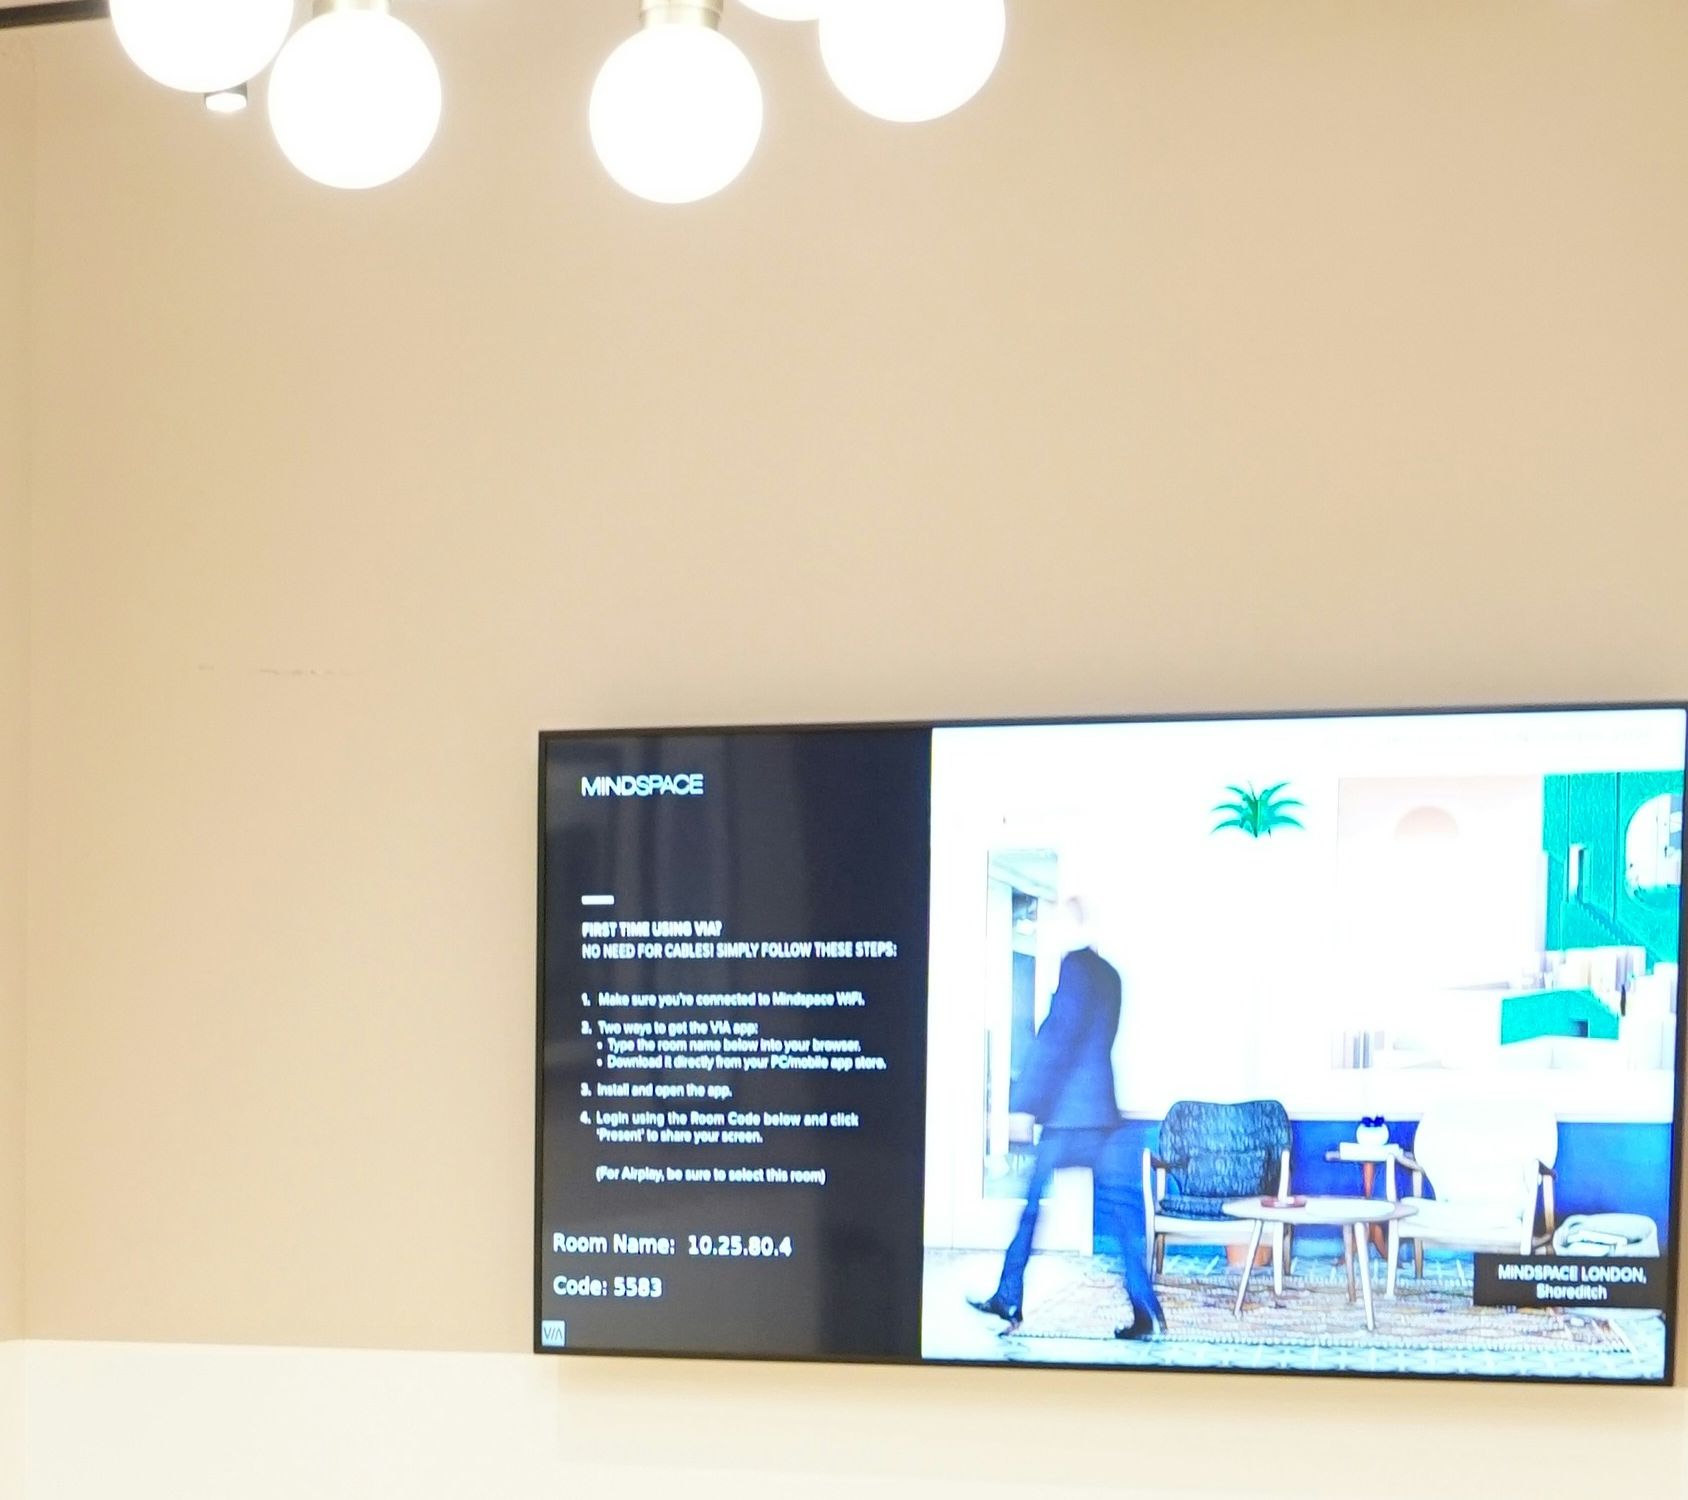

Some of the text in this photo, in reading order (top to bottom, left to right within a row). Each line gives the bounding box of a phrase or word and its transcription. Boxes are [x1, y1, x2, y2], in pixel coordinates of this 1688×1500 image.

[581, 774, 704, 796] MINDSPACE
[582, 920, 722, 937] FIRST TIME USING VIA?
[582, 943, 601, 959] NO
[603, 943, 635, 959] NEED
[637, 943, 662, 959] FOR
[716, 942, 759, 958] SIMPLY
[762, 941, 812, 958] FOLLOW
[814, 941, 853, 958] THESE
[855, 941, 897, 958] STEPS:
[599, 992, 630, 1006] Make
[632, 994, 656, 1006] sure
[696, 992, 756, 1007] connected
[758, 992, 770, 1006] to
[772, 991, 834, 1008] Mindspace
[598, 1020, 622, 1034] Two
[623, 1022, 652, 1036] ways
[654, 1021, 666, 1034] to
[668, 1022, 687, 1037] get
[689, 1021, 708, 1034] the
[607, 1037, 861, 1054] Type the room name below into your browser.
[607, 1054, 662, 1068] Download
[664, 1055, 672, 1068] it
[674, 1055, 714, 1071] directly
[716, 1055, 742, 1068] from
[743, 1057, 769, 1071] your
[831, 1057, 853, 1071] app
[597, 1082, 629, 1097] Install
[632, 1082, 653, 1097] and
[655, 1085, 684, 1099] open
[686, 1082, 706, 1097] the
[707, 1085, 732, 1100] app.
[632, 1111, 665, 1127] using
[667, 1111, 687, 1125] the
[691, 1111, 724, 1125] Room
[727, 1111, 761, 1126] Code
[763, 1112, 801, 1126] below
[804, 1112, 827, 1126] and
[830, 1112, 859, 1127] click
[647, 1129, 659, 1142] to
[661, 1129, 692, 1143] share
[693, 1131, 720, 1145] your
[722, 1131, 763, 1143] screen.
[596, 1166, 620, 1182] (For
[667, 1167, 683, 1181] be
[685, 1169, 712, 1182] sure
[714, 1168, 727, 1182] to
[728, 1168, 764, 1182] select
[766, 1168, 789, 1182] this
[790, 1169, 826, 1185] room)
[553, 1232, 792, 1257] Room Name: 10.25.80.4
[1498, 1264, 1578, 1282] MINDSPACE
[553, 1275, 662, 1297] Code: 5583
[1536, 1283, 1608, 1300] Shoreditch
